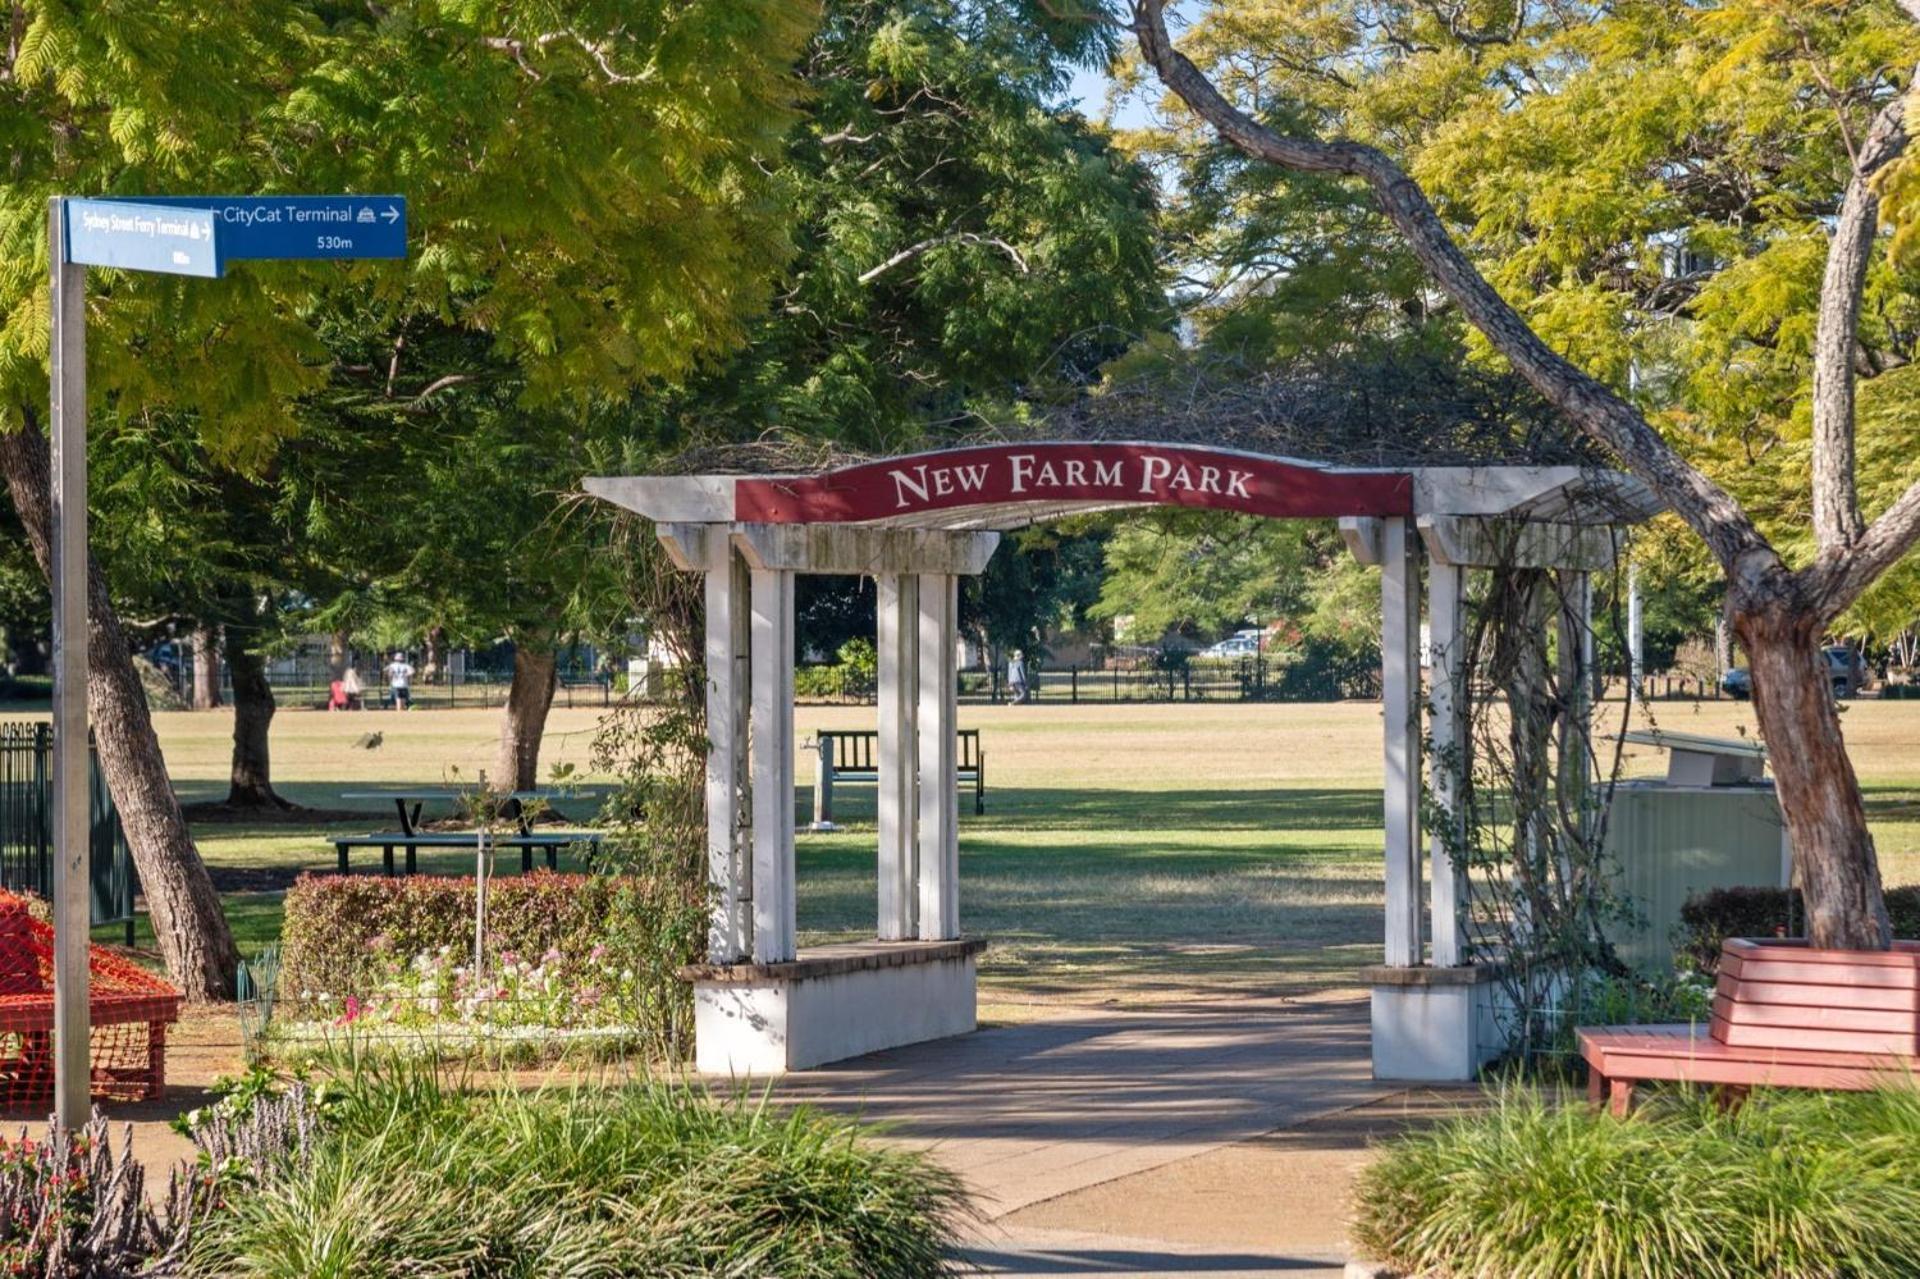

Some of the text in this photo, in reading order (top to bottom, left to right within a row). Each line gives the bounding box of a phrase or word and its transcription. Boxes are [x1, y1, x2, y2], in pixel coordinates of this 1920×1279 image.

[83, 210, 109, 234] Sydney
[156, 217, 190, 238] Terminal
[223, 205, 352, 227] CityCat Terminal
[317, 236, 353, 249] 530m
